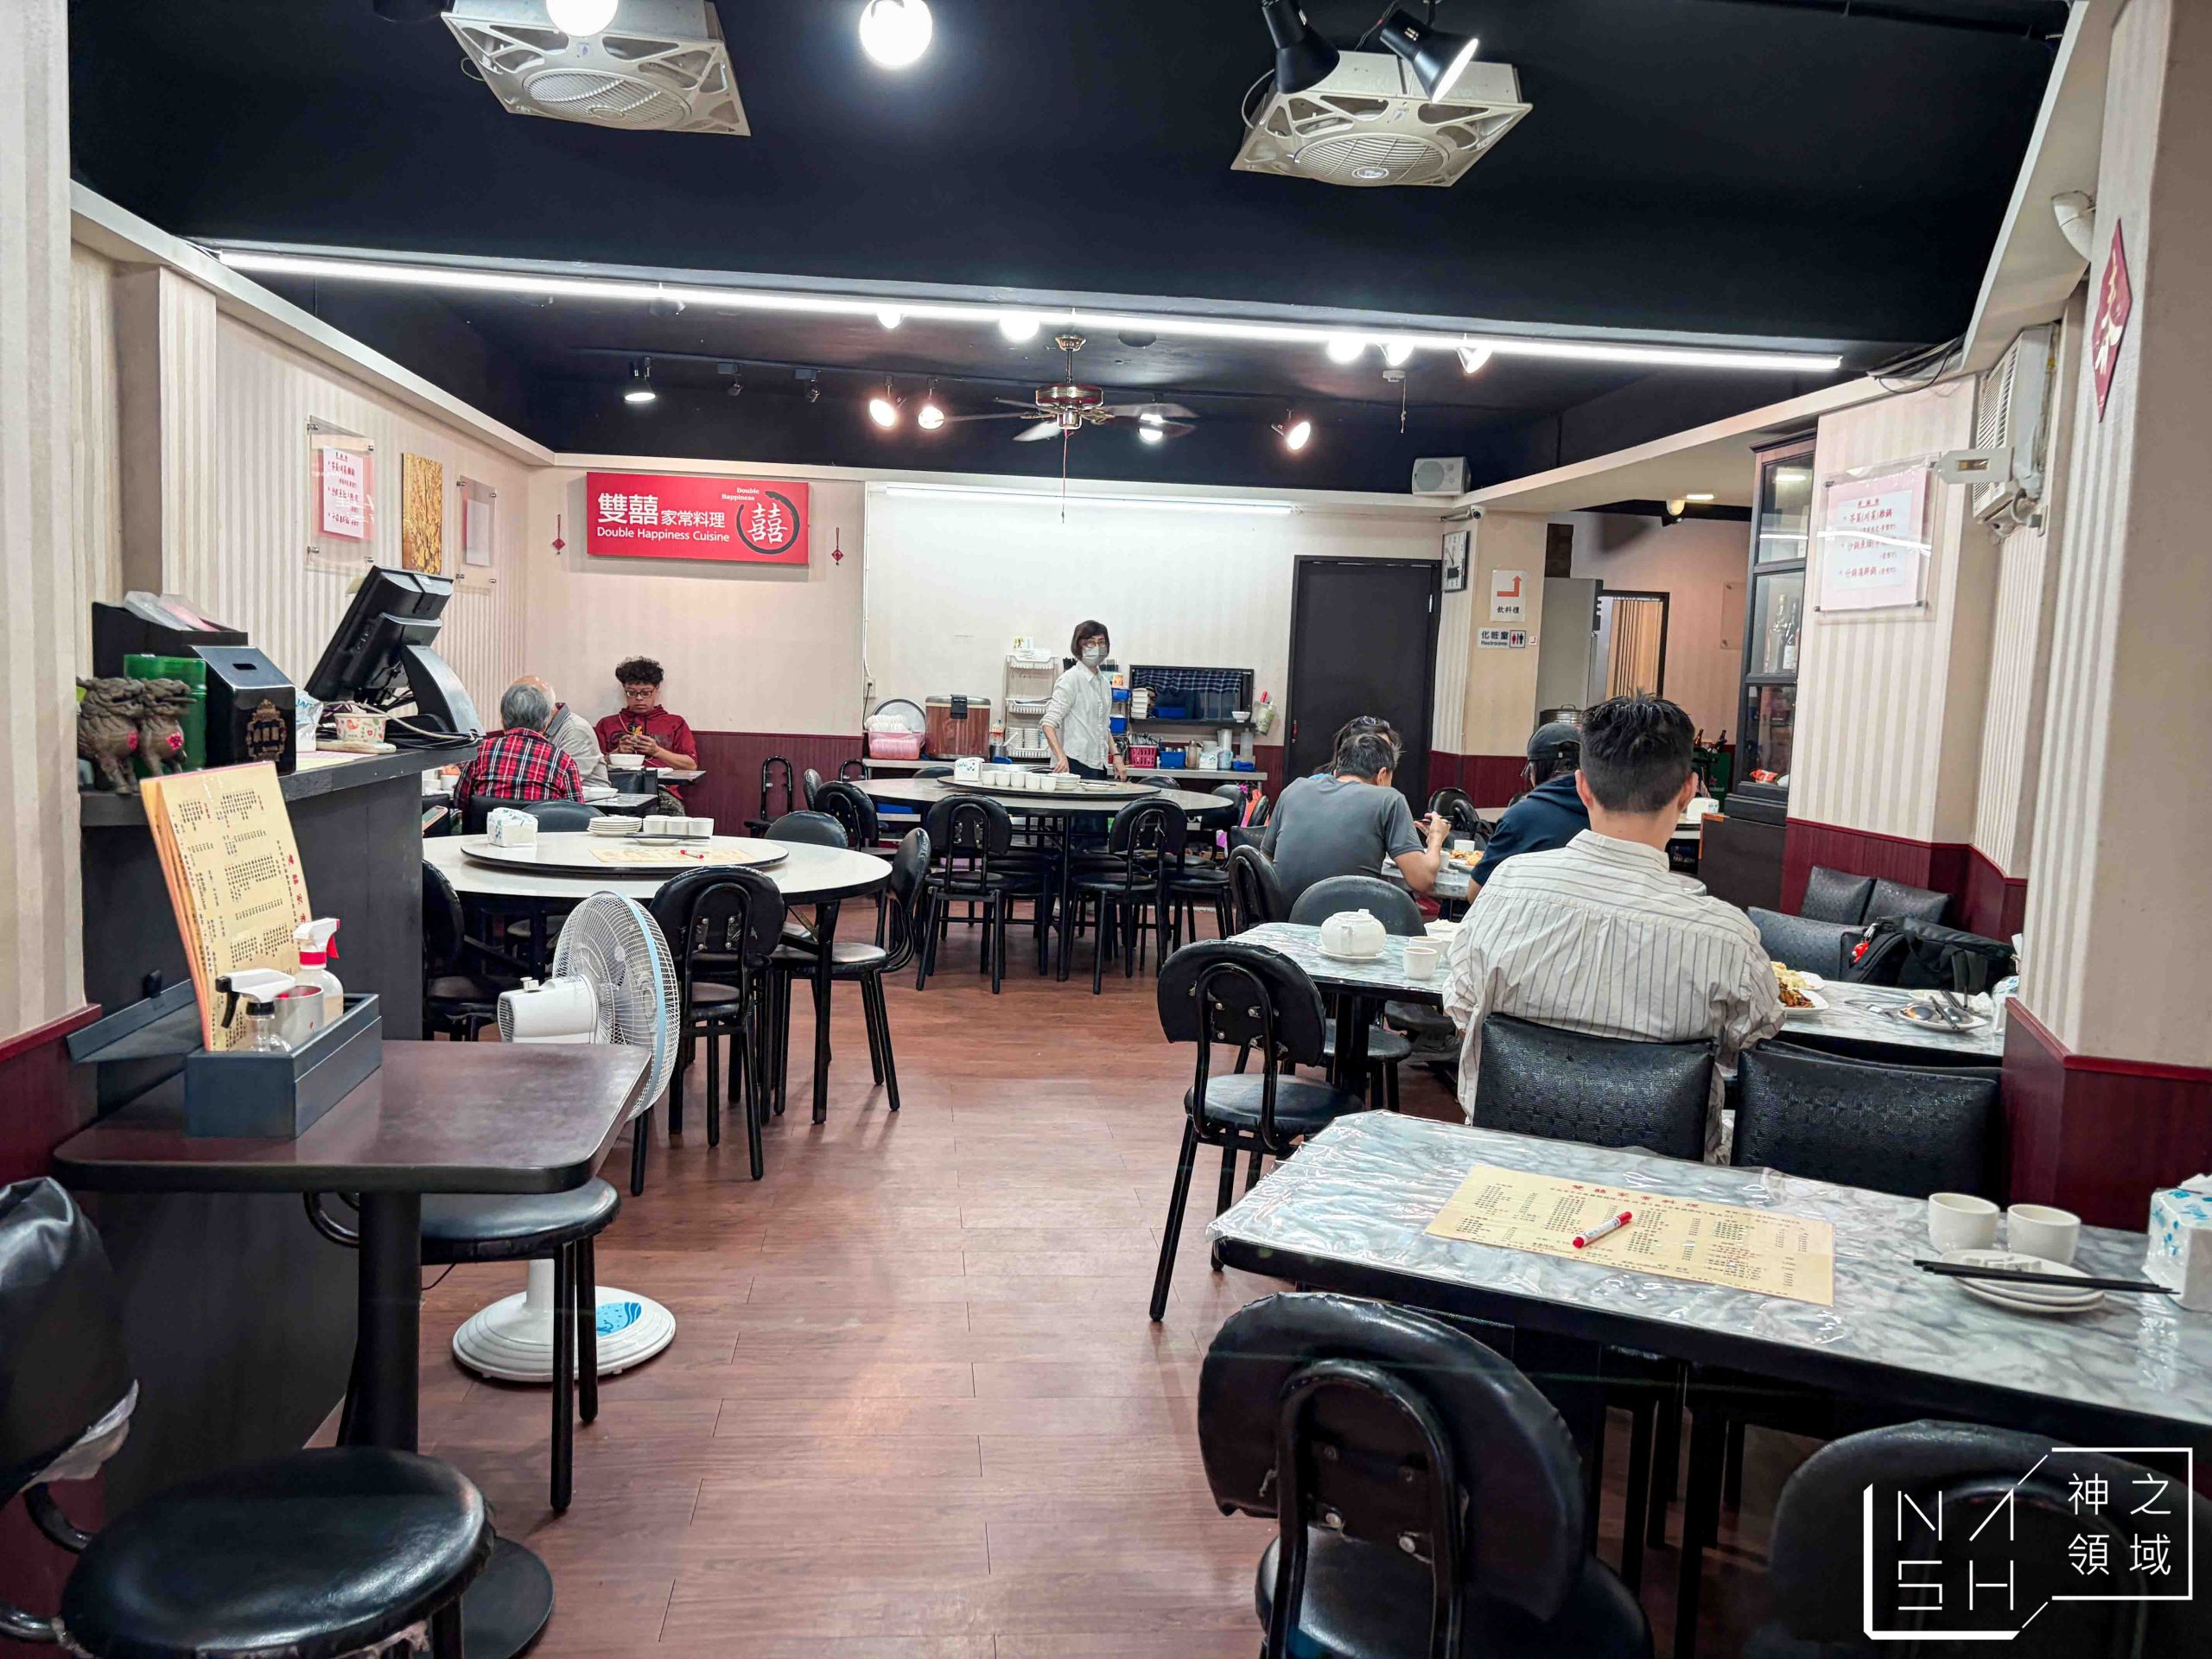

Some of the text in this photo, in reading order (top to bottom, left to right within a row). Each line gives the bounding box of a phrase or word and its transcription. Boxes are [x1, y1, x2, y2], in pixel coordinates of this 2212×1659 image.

[597, 493, 725, 528] 雙囍 家常料理
[747, 502, 788, 543] 囍
[597, 526, 730, 543] Double Happiness Cuisine
